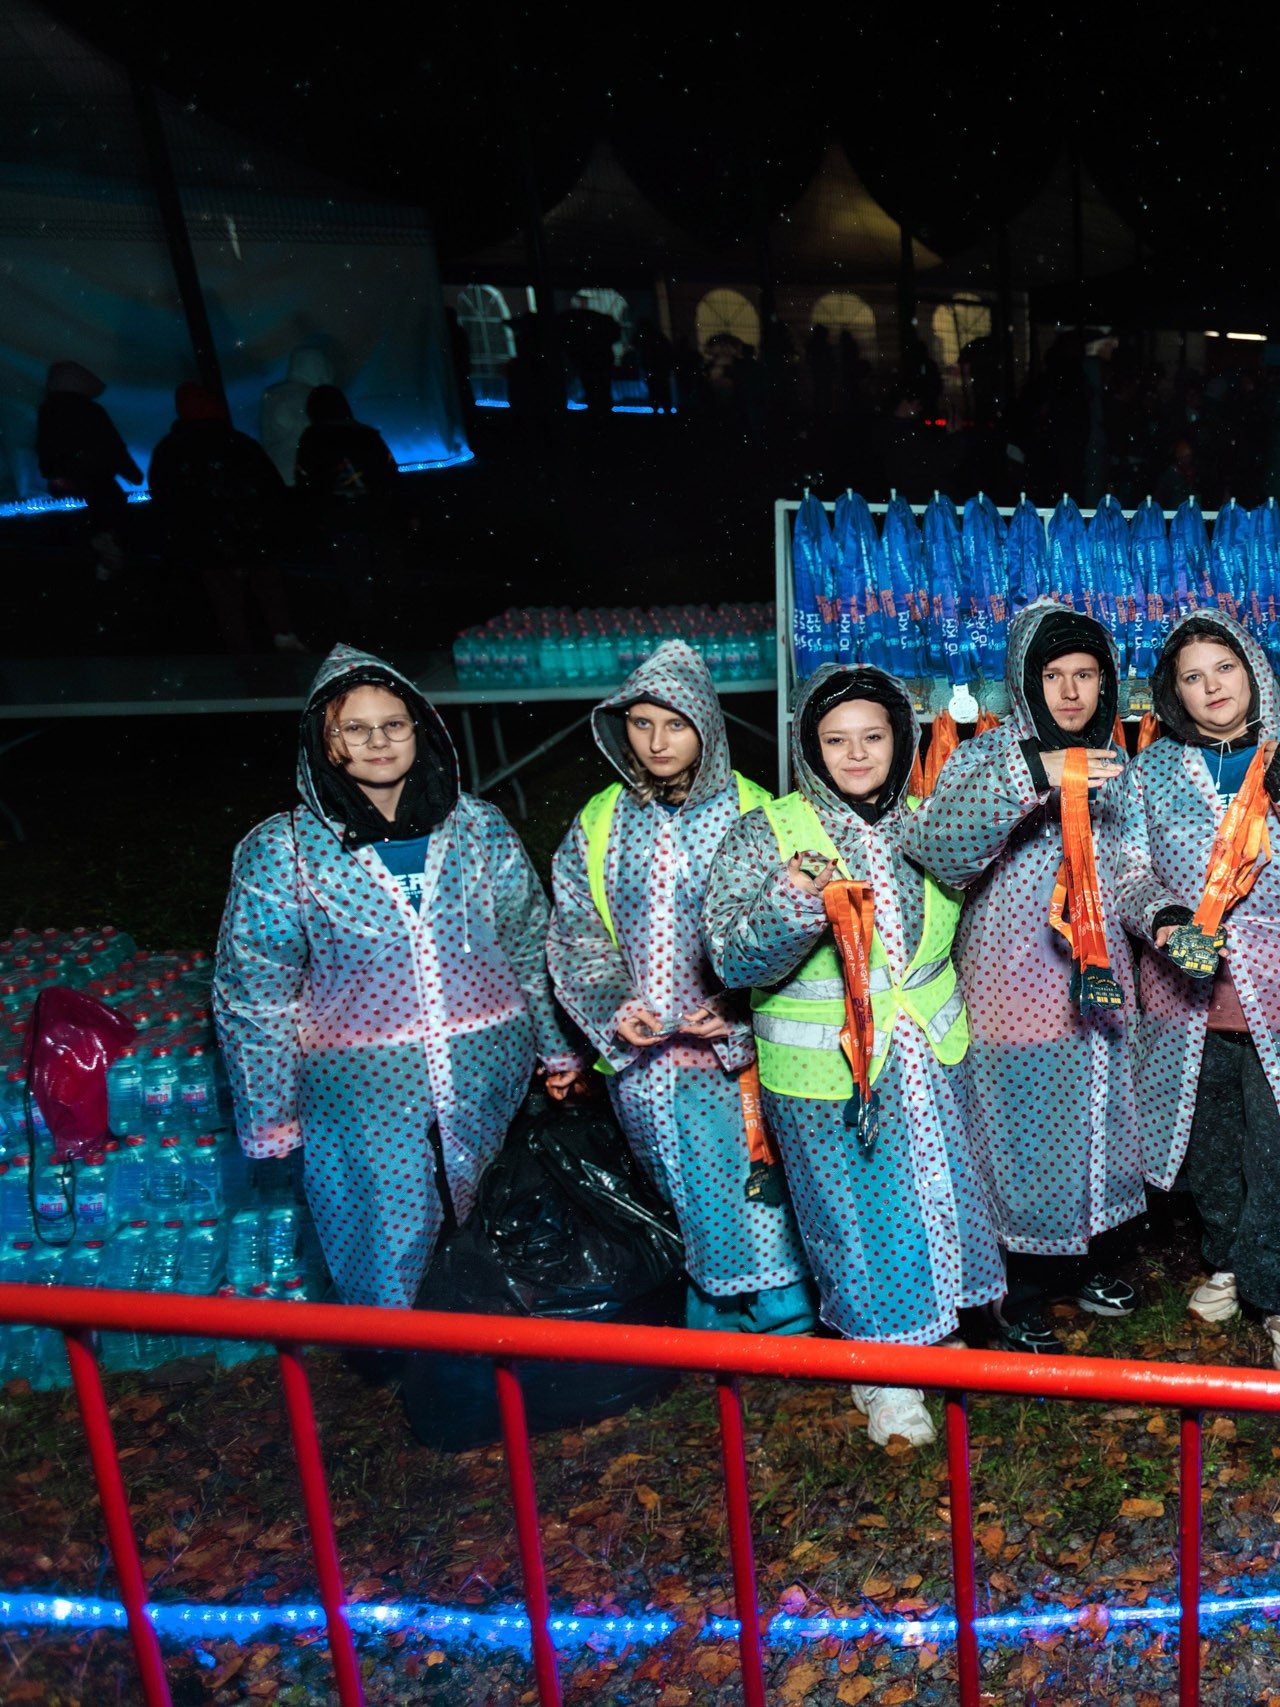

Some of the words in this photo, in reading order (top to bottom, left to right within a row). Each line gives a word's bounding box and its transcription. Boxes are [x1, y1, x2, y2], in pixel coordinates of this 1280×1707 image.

[841, 613, 851, 633] KM
[946, 618, 957, 638] KM
[1134, 612, 1143, 632] KM
[840, 638, 850, 652] 10
[841, 934, 854, 961] LASER
[859, 962, 869, 987] NIGHT
[742, 1093, 756, 1114] KM
